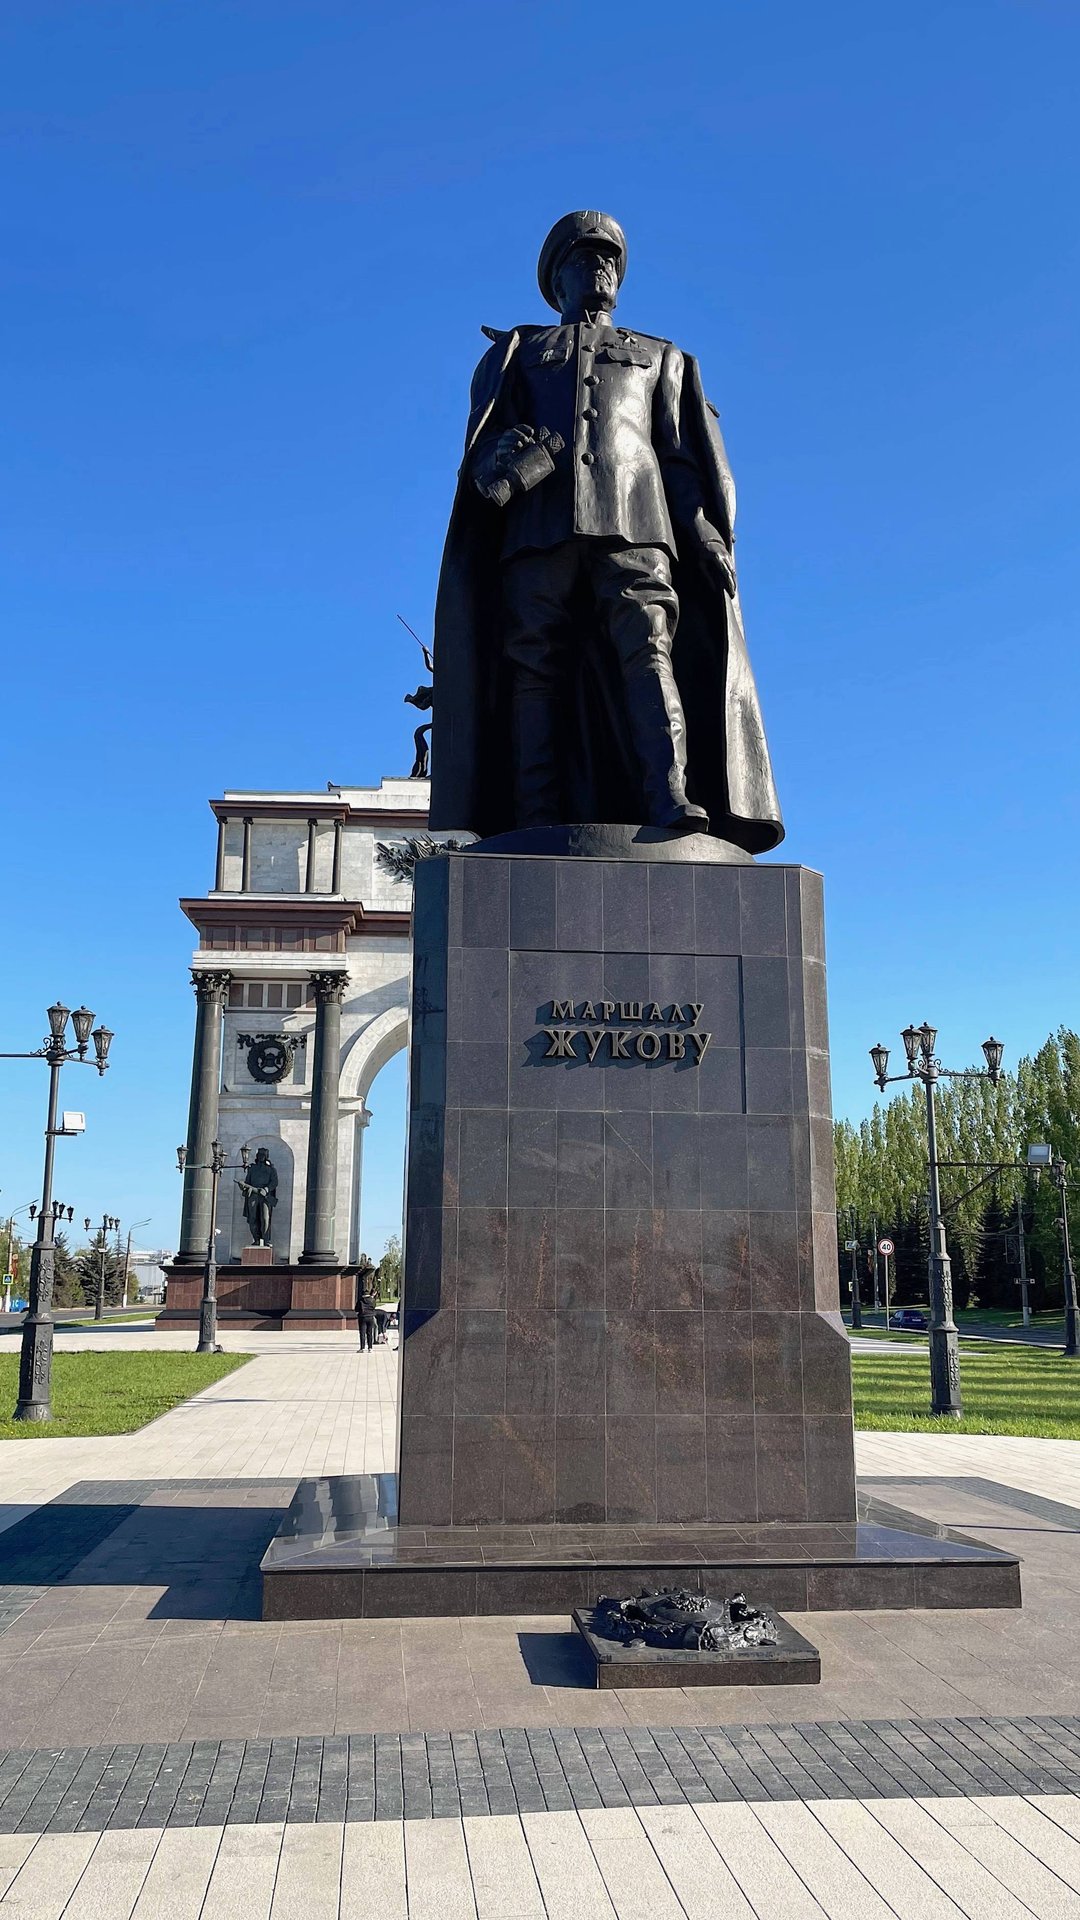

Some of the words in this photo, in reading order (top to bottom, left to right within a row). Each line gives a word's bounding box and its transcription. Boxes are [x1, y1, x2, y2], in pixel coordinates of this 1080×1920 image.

[551, 1000, 704, 1027] МАРШАЛУ
[543, 1029, 712, 1065] ЖУКОВУ
[881, 1243, 891, 1251] 40
